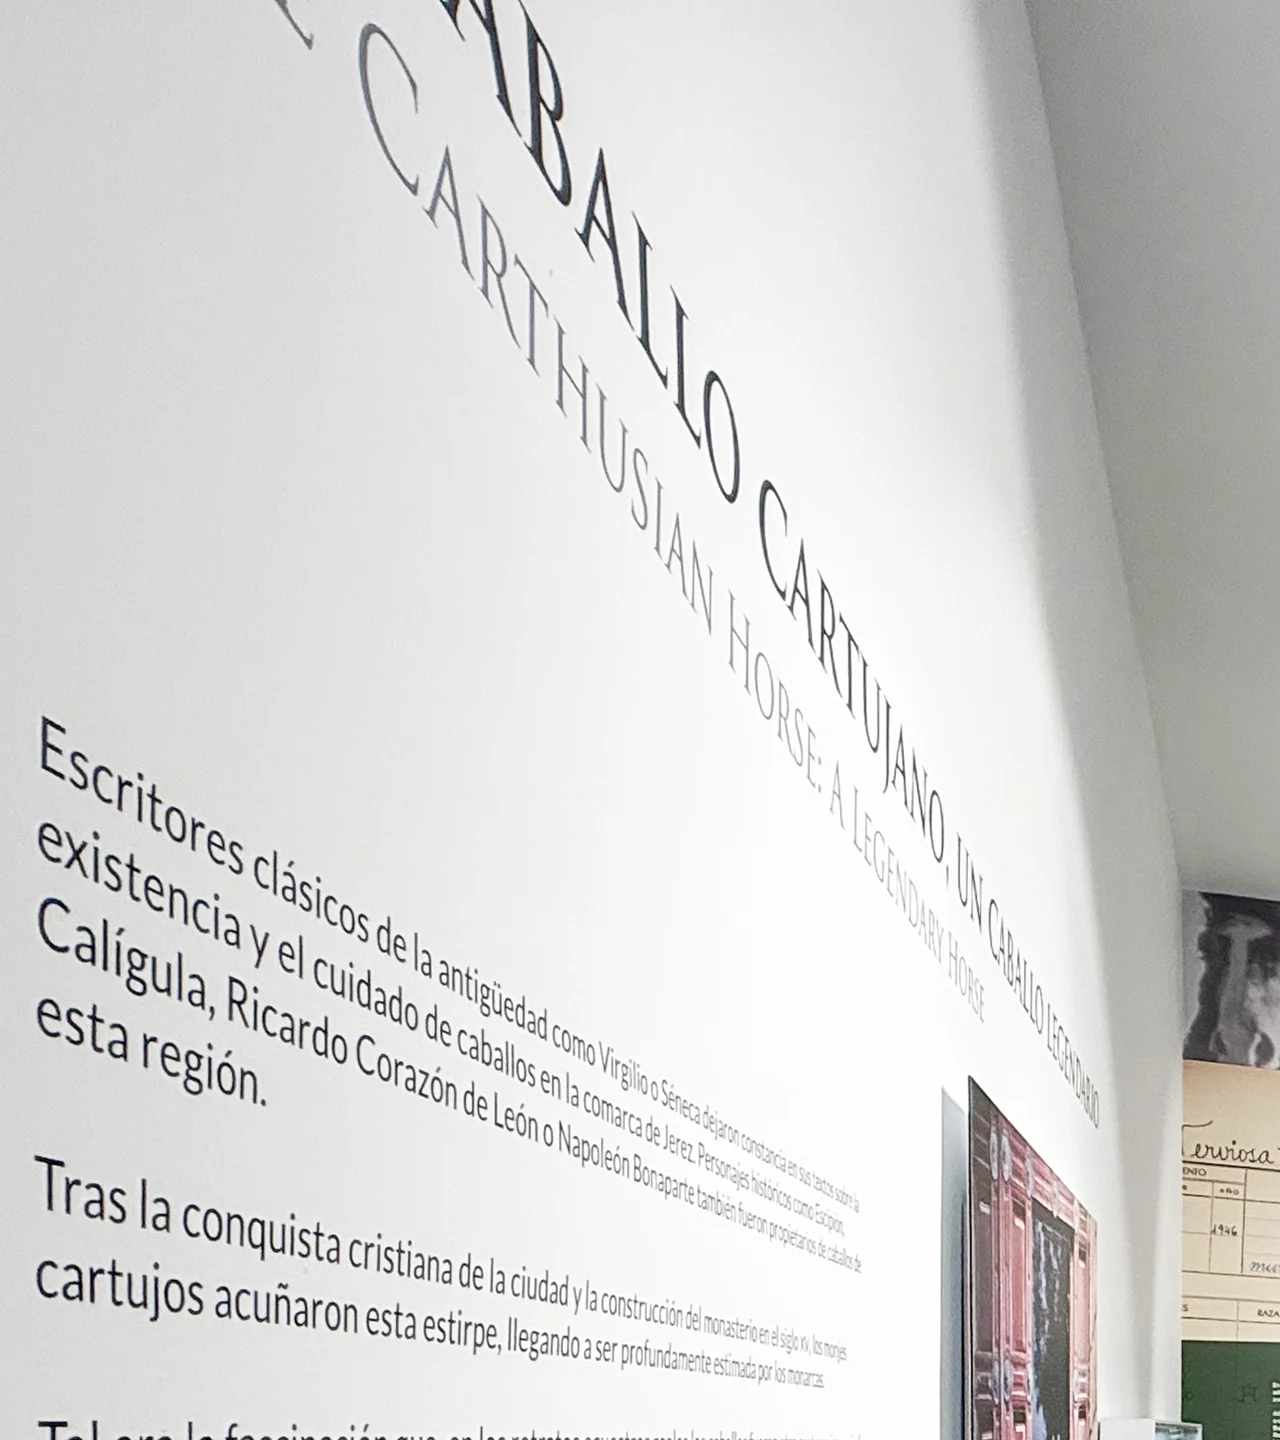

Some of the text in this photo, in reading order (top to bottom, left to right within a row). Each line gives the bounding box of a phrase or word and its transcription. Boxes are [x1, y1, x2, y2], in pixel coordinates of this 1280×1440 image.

[359, 23, 985, 1023] CARTHUSIAN HORSE: A LEGENDARY HORSE
[40, 715, 433, 979] Escritores clásicos de la
[758, 479, 950, 890] CARTUJANO,
[956, 832, 983, 933] UN
[989, 898, 1044, 1035] CABALLO
[1047, 1002, 1100, 1129] LEGENDARIO
[38, 822, 419, 1032] existencia y el cuidado
[38, 897, 348, 1065] Calígula, Ricardo
[37, 998, 266, 1107] esta región.
[34, 1155, 341, 1264] Tras la conquista
[36, 1259, 416, 1340] cartujos acuñaron esta
[1257, 1309, 1280, 1318] RAZA
